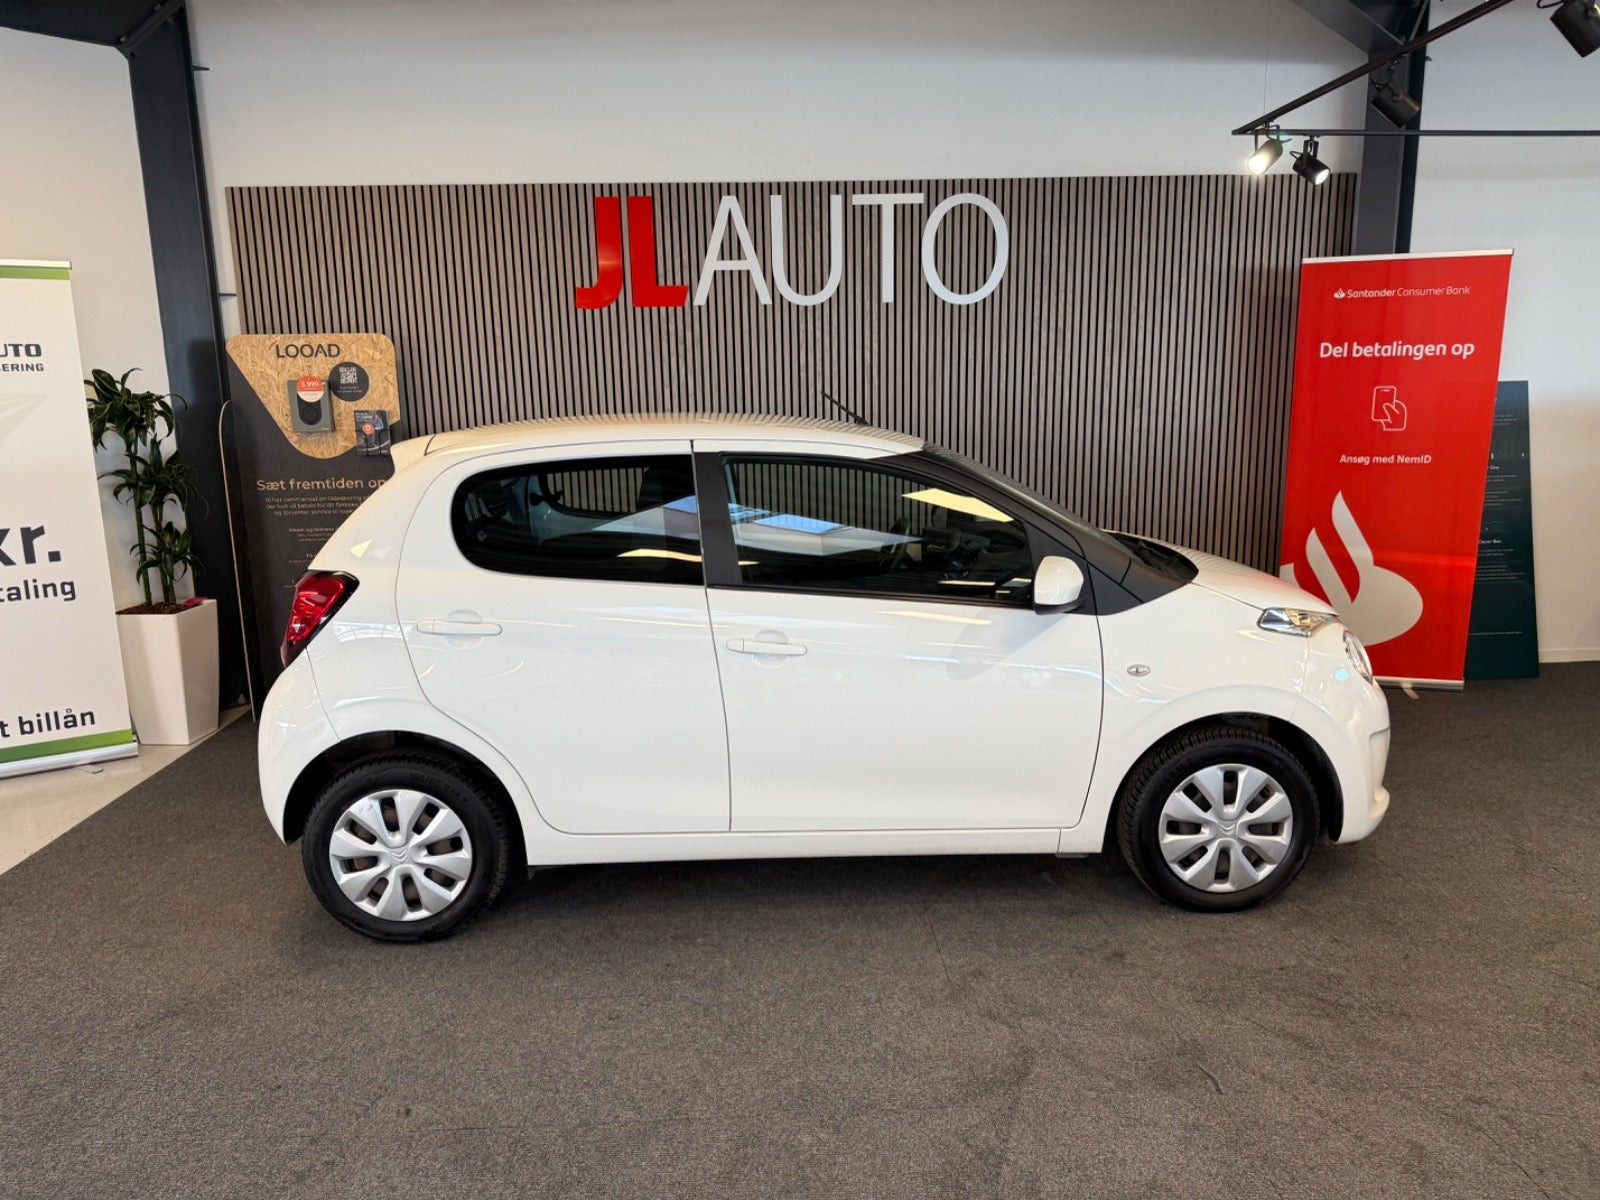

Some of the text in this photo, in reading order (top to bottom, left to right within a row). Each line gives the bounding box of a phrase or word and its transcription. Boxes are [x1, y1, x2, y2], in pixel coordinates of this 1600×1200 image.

[1346, 285, 1471, 298] Santander Consumer Bank
[275, 343, 341, 358] LOOAD
[1319, 340, 1475, 360] Del betalingen op
[0, 363, 44, 372] ERING
[1339, 454, 1432, 466] Ansøg med NemID
[256, 479, 286, 491] Sæt
[289, 477, 364, 490] fremtiden
[18, 708, 96, 736] billån
